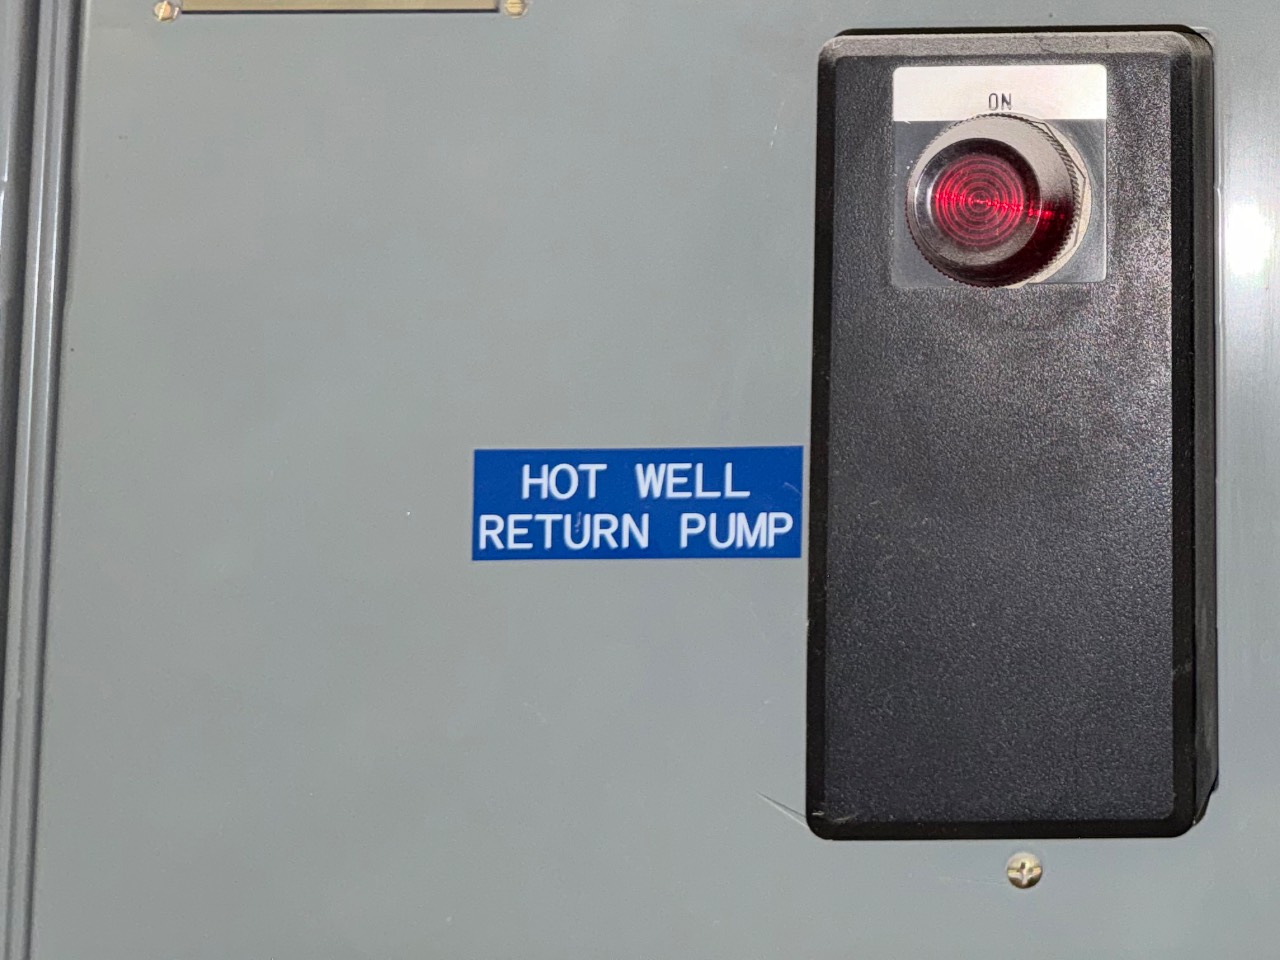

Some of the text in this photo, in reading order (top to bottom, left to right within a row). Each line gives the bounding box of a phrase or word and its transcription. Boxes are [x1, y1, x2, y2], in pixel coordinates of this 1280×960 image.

[988, 92, 1012, 111] ON
[522, 462, 751, 500] HOT WELL
[479, 511, 794, 550] RETURN PUMP
